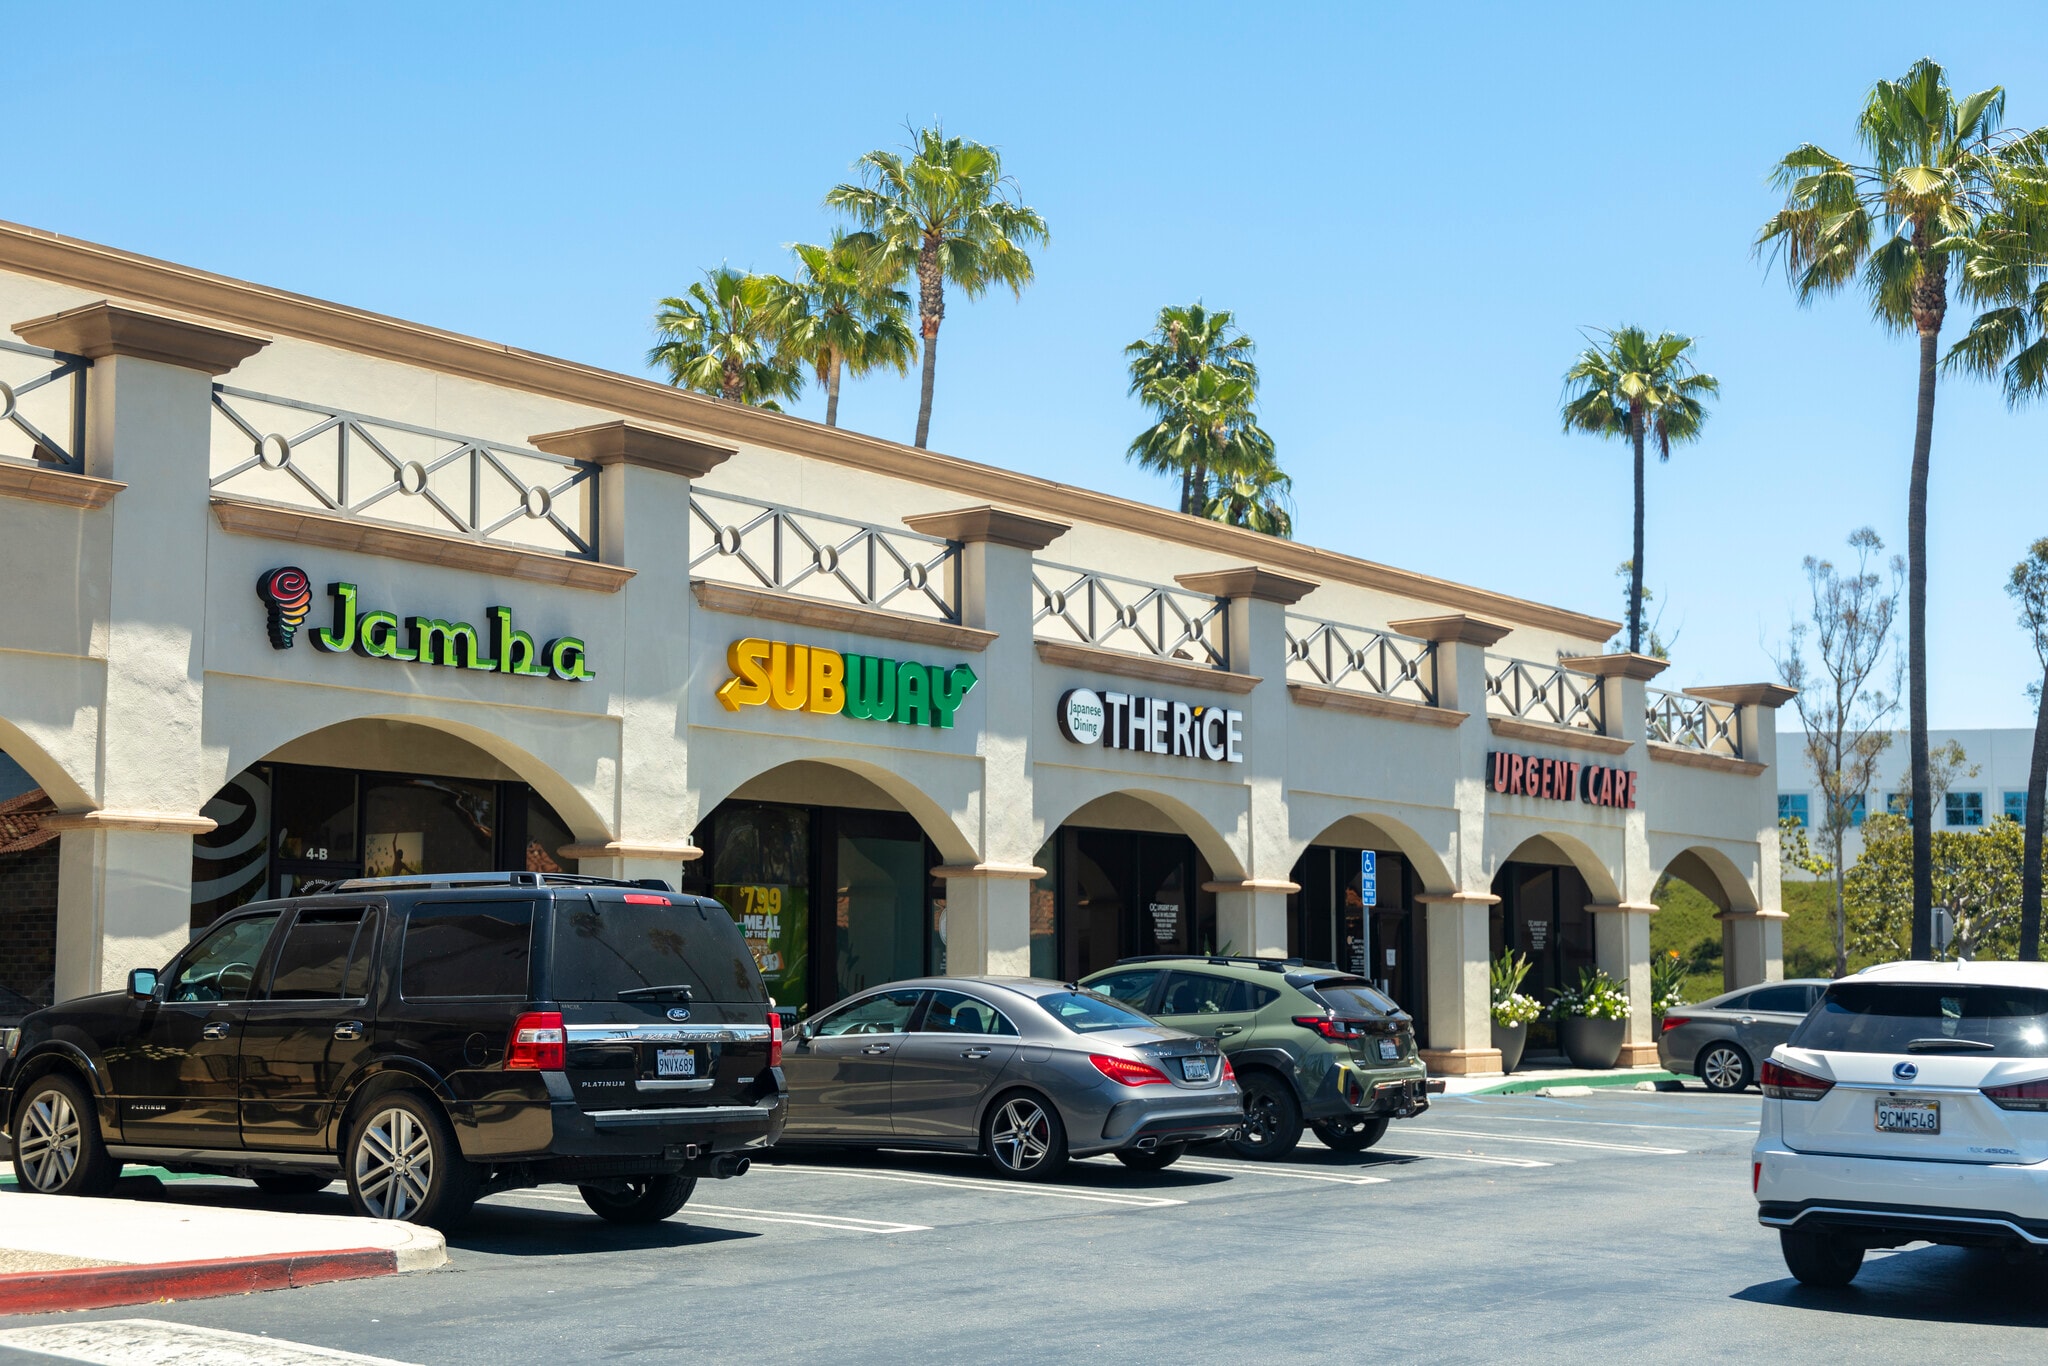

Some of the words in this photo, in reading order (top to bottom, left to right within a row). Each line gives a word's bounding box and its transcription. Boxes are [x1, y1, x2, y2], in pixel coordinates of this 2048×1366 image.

[312, 582, 596, 682] Jamba
[716, 638, 978, 729] SUBWAY
[1069, 700, 1102, 717] Japanese
[1073, 717, 1098, 737] Dining
[1490, 752, 1580, 801] URGENT
[1584, 764, 1638, 809] CARE
[306, 847, 328, 860] 4-B
[740, 886, 782, 914] $7.99
[743, 914, 781, 930] MEAL
[744, 930, 754, 938] OF
[754, 930, 767, 938] THE
[659, 1058, 694, 1073] 9NVX689
[581, 1080, 626, 1088] PLATINUM
[1879, 1111, 1935, 1129] 9CMW548
